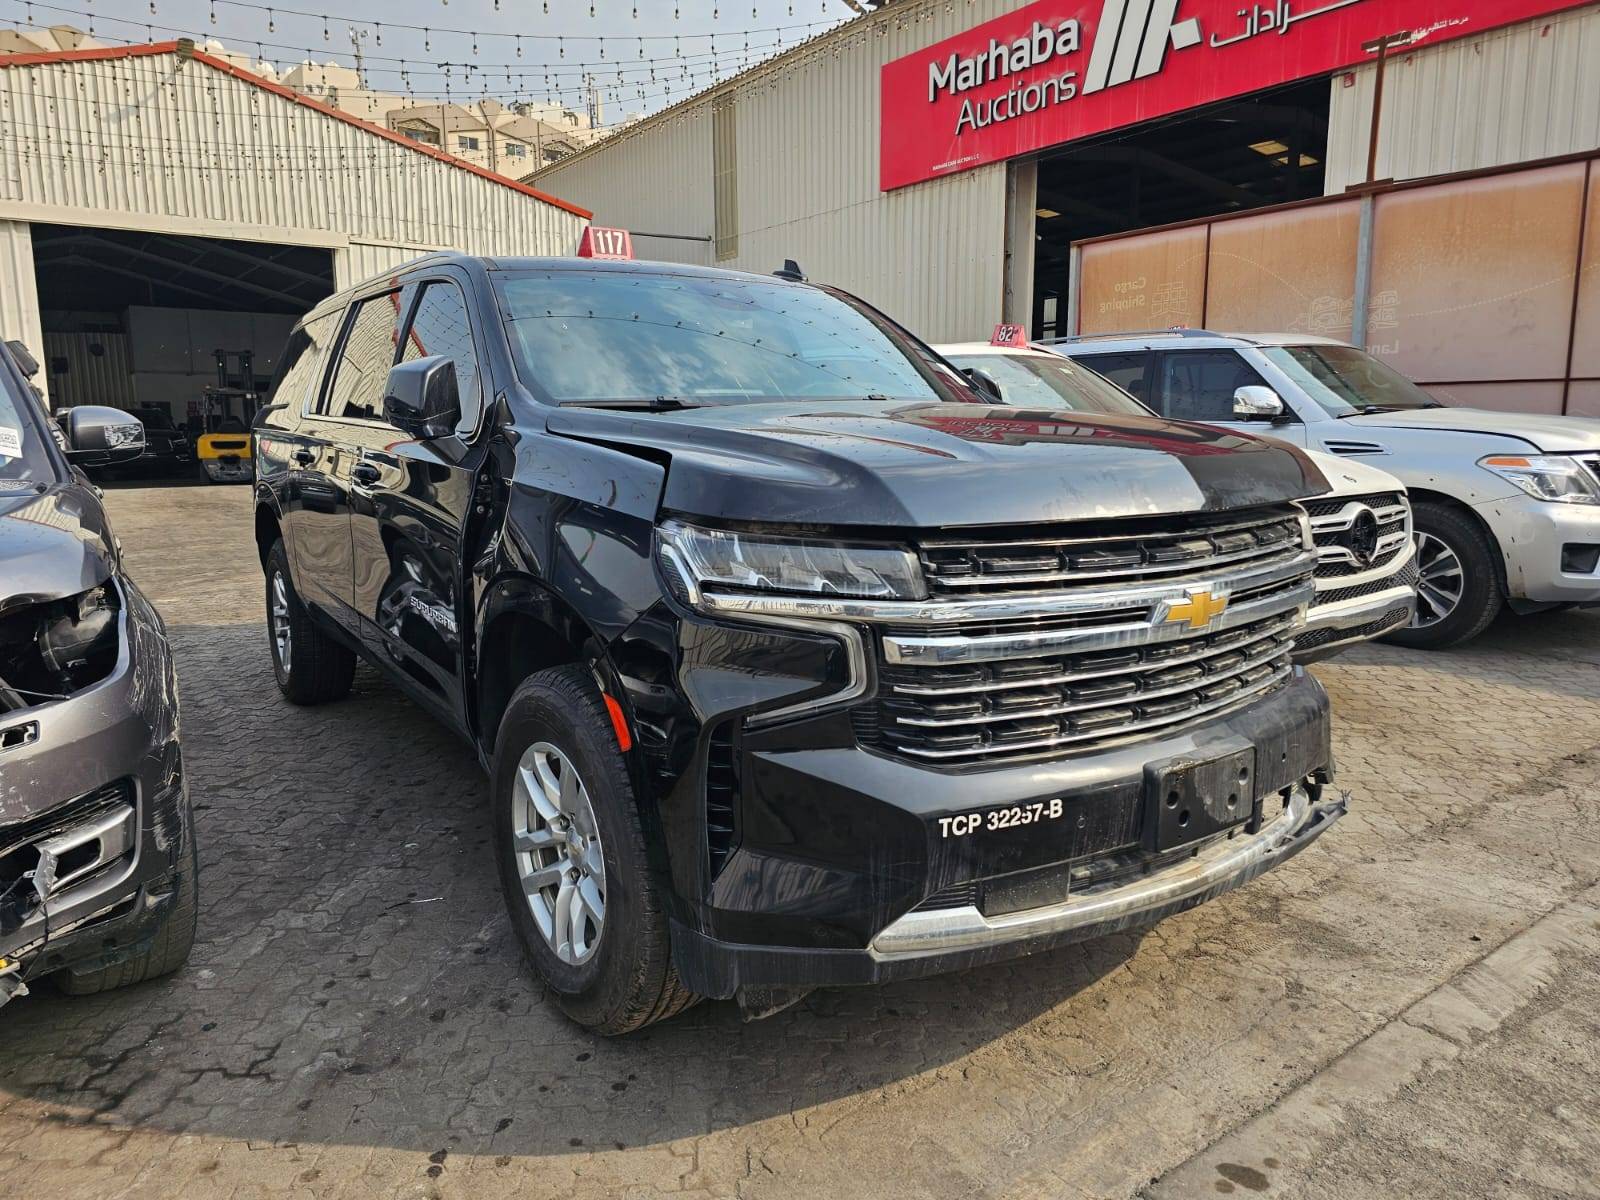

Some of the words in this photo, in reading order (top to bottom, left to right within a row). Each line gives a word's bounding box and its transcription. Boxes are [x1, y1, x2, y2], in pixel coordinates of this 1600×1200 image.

[928, 19, 1081, 102] Marhaba
[955, 71, 1077, 135] Auctions
[597, 230, 623, 255] 117
[410, 596, 458, 633] SUBURBAN
[939, 813, 982, 838] TCP
[987, 799, 1063, 831] 32257-B
